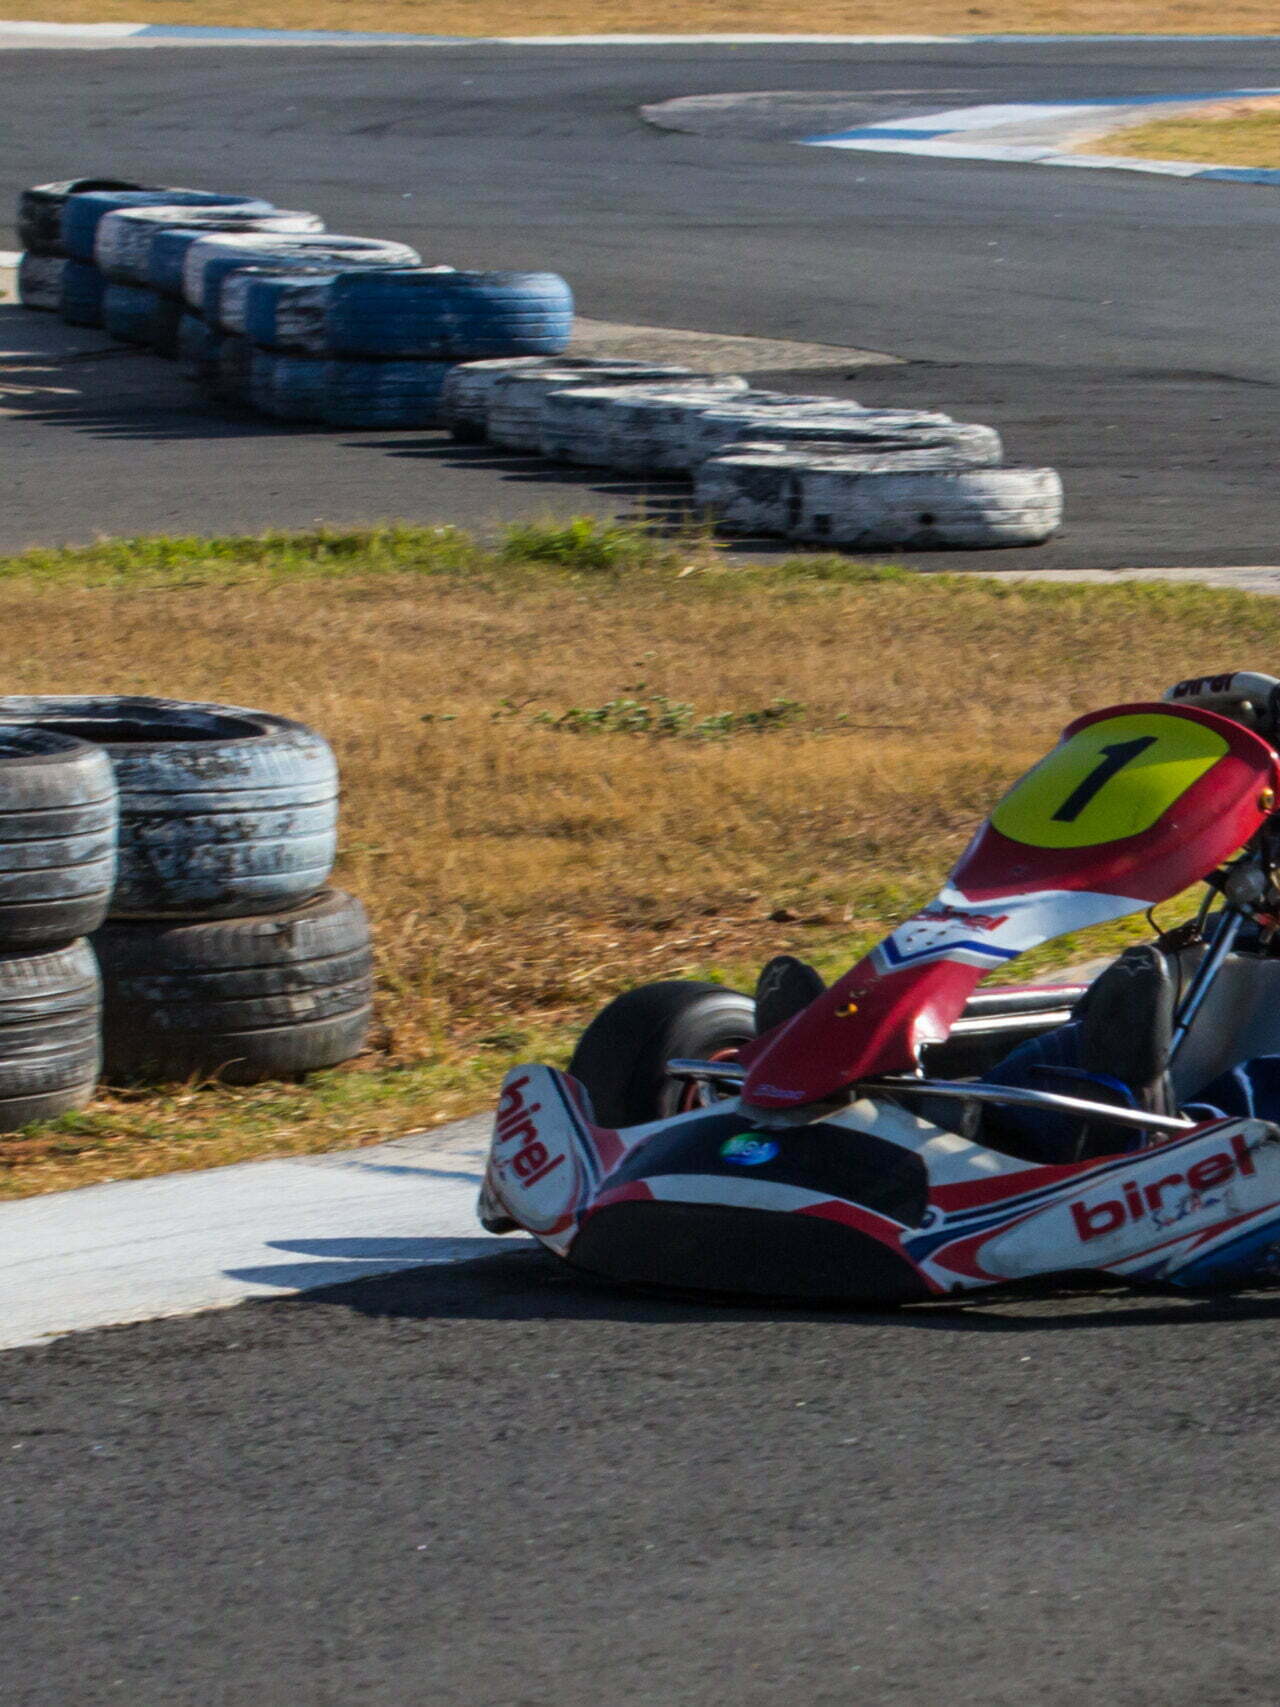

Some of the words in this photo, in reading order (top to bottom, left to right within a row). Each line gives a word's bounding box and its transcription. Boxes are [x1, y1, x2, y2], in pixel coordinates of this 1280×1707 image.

[1050, 736, 1159, 823] 1
[497, 1075, 565, 1188] birel
[1069, 1134, 1256, 1242] birel
